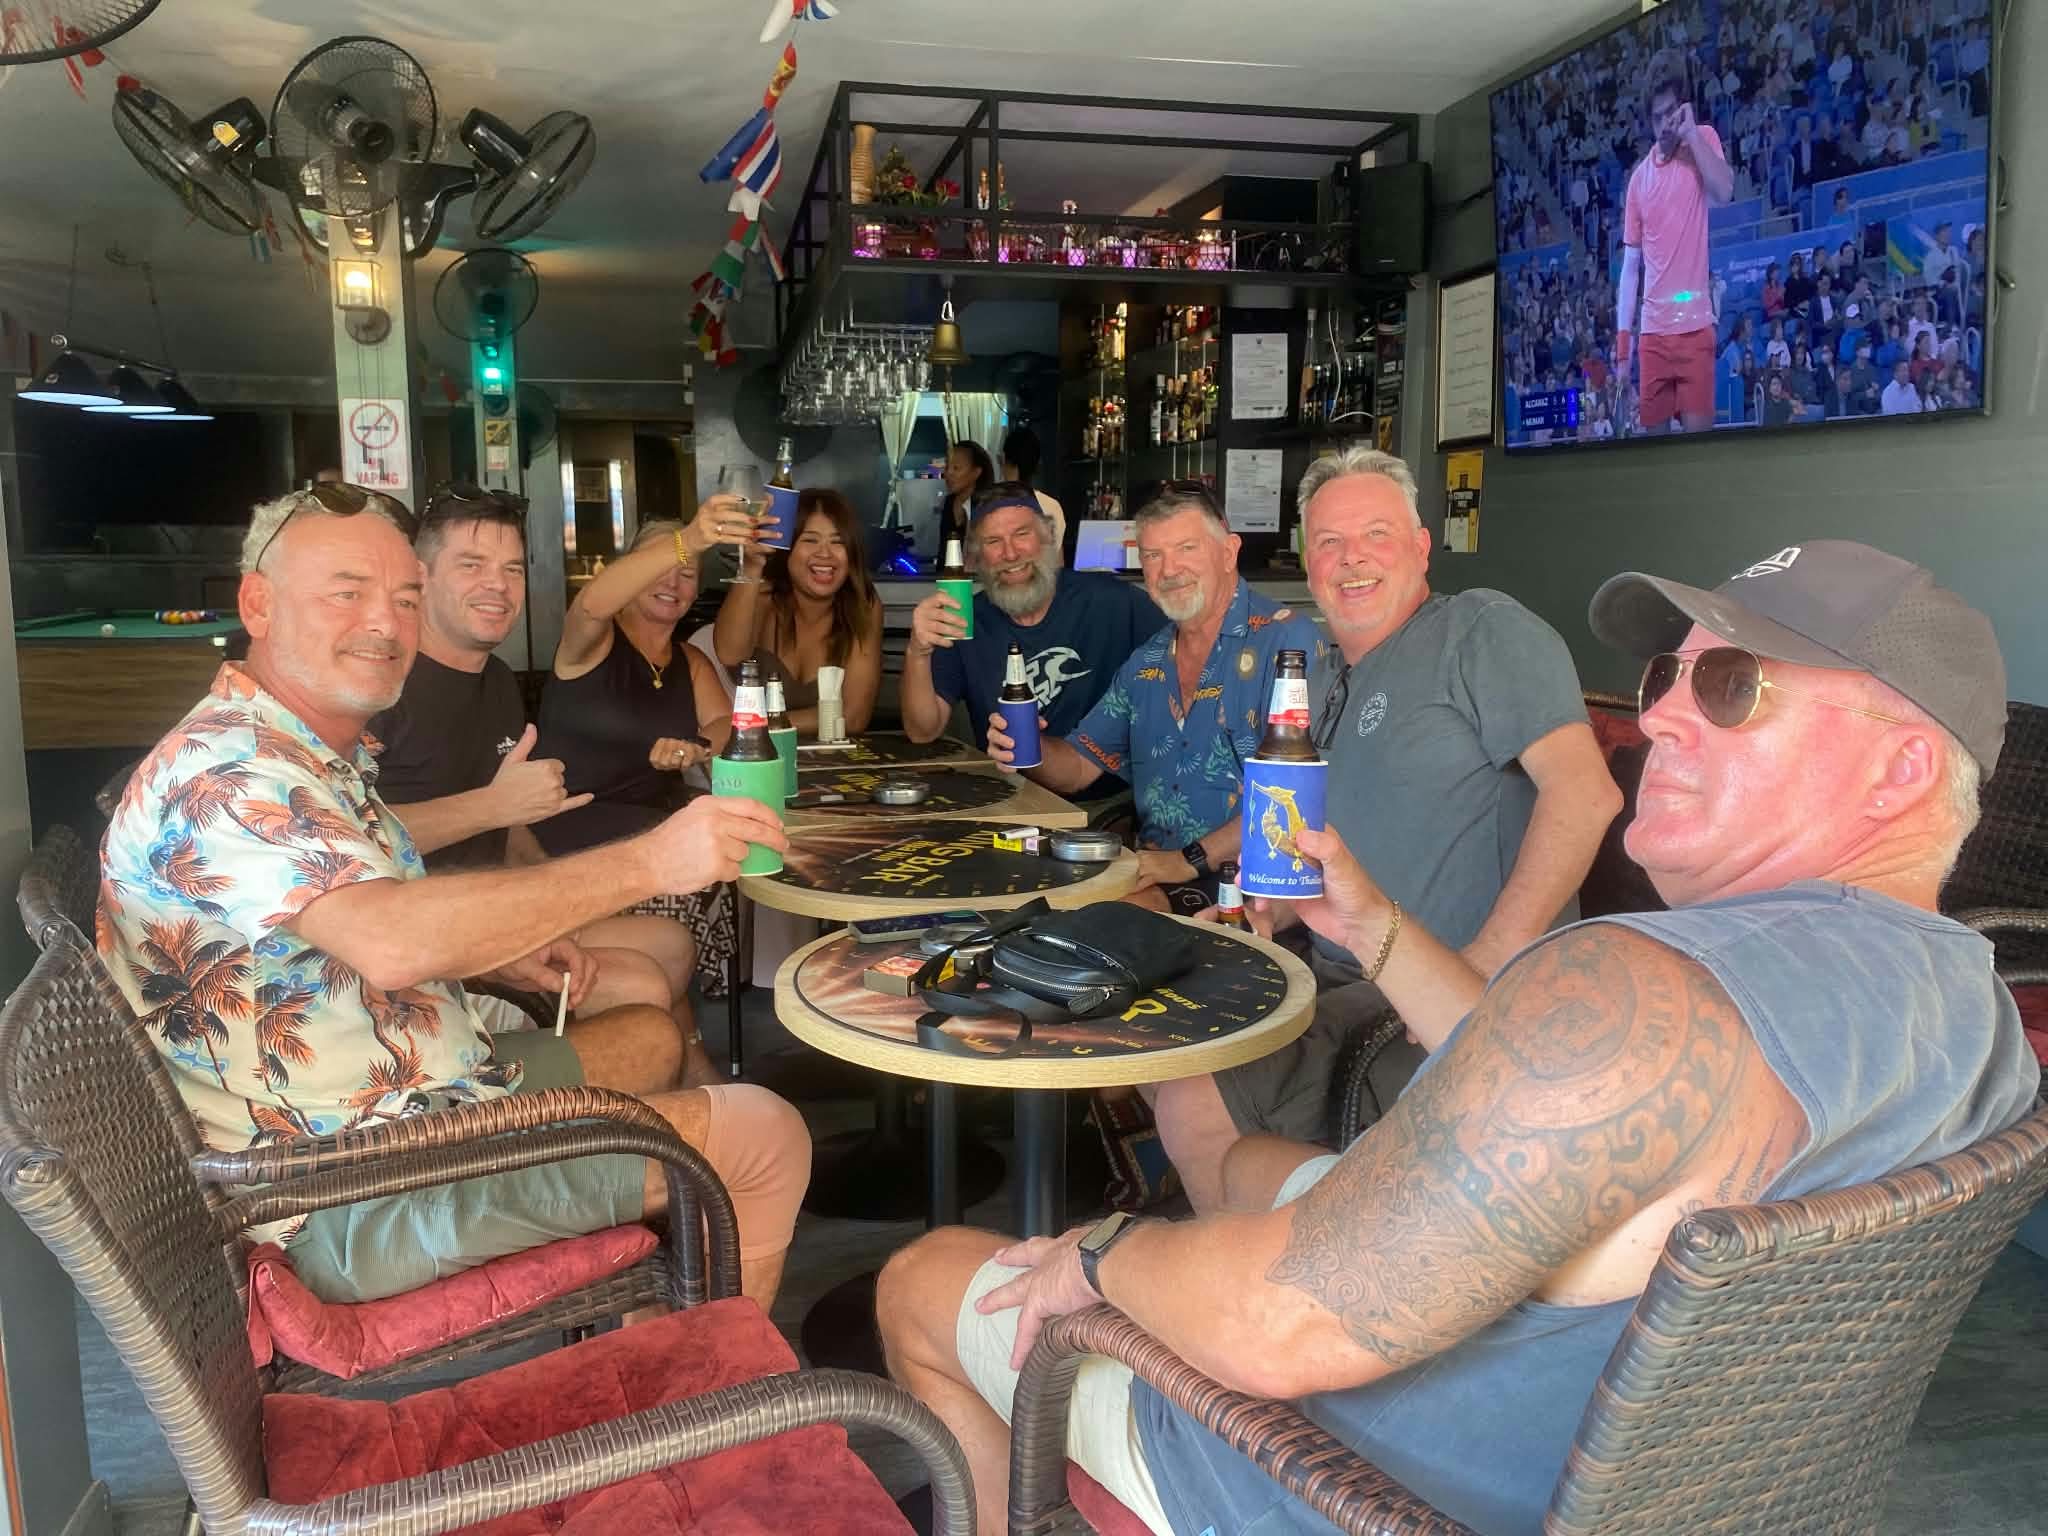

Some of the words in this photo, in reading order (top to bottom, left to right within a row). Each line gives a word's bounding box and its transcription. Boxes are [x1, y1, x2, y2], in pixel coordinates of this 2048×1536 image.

[861, 856, 952, 882] BAR
[1249, 873, 1286, 885] Welcome
[1288, 876, 1298, 885] to
